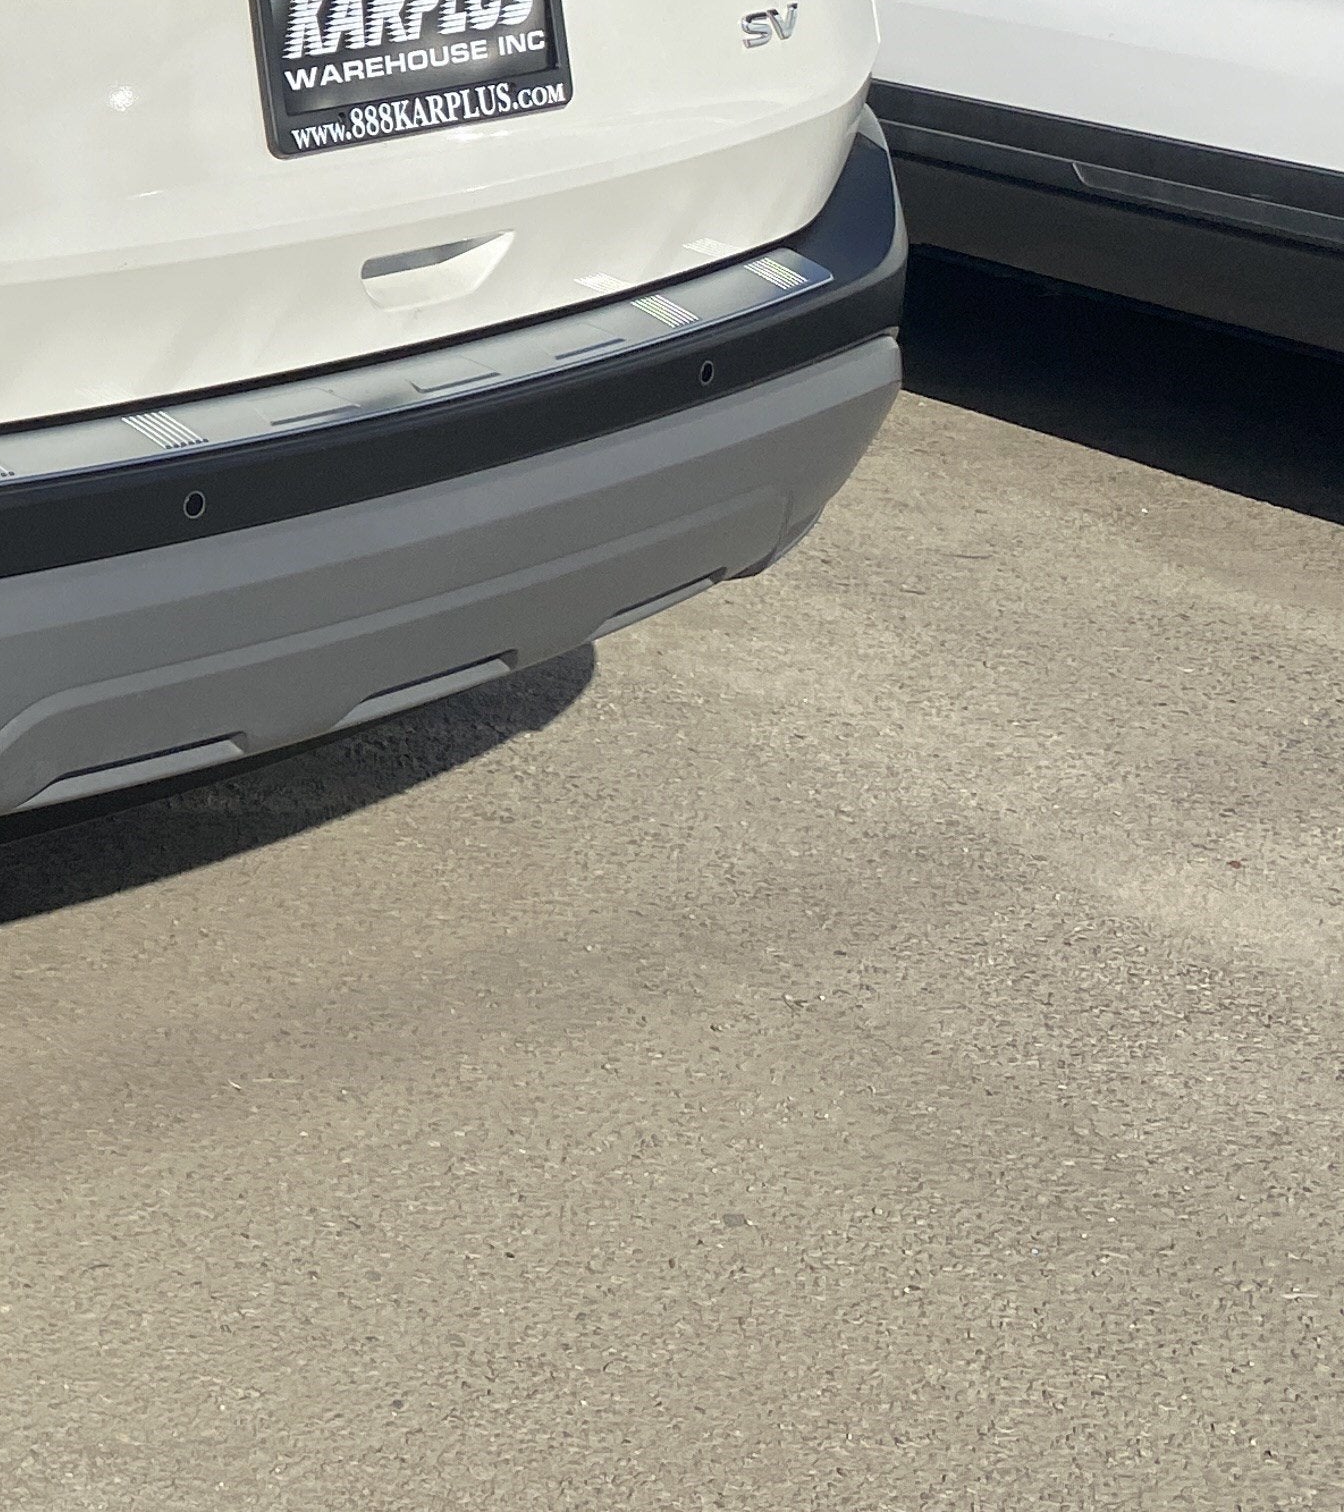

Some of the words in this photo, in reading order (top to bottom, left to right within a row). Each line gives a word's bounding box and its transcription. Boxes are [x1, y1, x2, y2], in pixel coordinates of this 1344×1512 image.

[741, 1, 800, 49] SV
[284, 39, 490, 92] WAREHOUSE
[498, 29, 546, 55] INC
